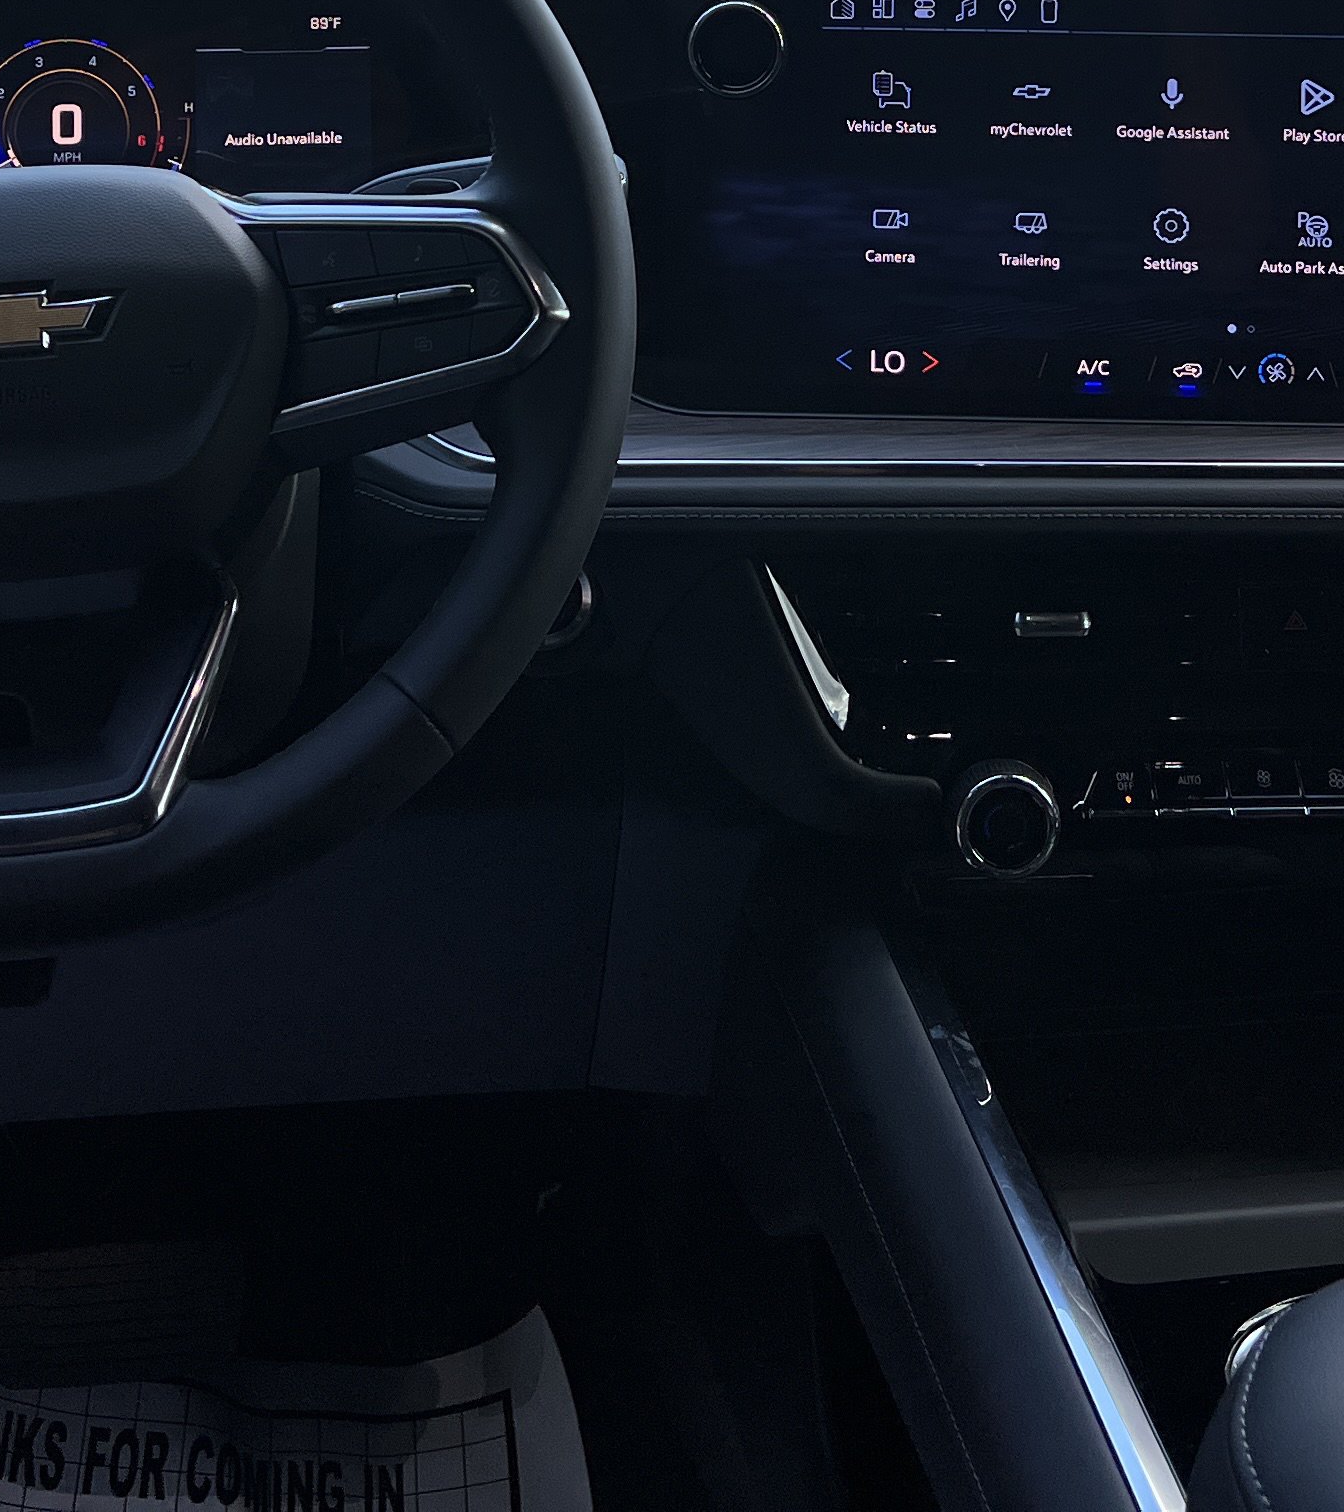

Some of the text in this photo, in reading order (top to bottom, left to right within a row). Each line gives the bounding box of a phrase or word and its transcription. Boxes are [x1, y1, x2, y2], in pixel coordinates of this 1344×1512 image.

[310, 17, 342, 30] 89°F
[35, 57, 44, 68] 3
[88, 56, 97, 67] 4
[128, 85, 136, 97] 5
[184, 102, 194, 113] H
[51, 103, 82, 146] 0
[847, 118, 937, 135] Vehicle Status
[990, 122, 1073, 141] myChevrolet
[137, 135, 146, 147] 6
[225, 131, 343, 147] Audio Unavailable
[1116, 124, 1230, 143] Google Assistant
[1283, 128, 1312, 146] Play
[53, 152, 82, 163] MPH
[1298, 236, 1333, 249] AUTO
[864, 248, 916, 265] Camera
[999, 252, 1061, 271] Trailering
[1143, 256, 1199, 275] Settings
[1259, 261, 1292, 276] Auto
[1295, 261, 1325, 276] Park
[869, 349, 906, 375] LO
[1077, 359, 1110, 377] A/C
[1178, 774, 1202, 785] AUTO
[81, 1424, 169, 1500] FOR
[187, 1434, 345, 1512] COMING
[363, 1462, 405, 1512] IN
